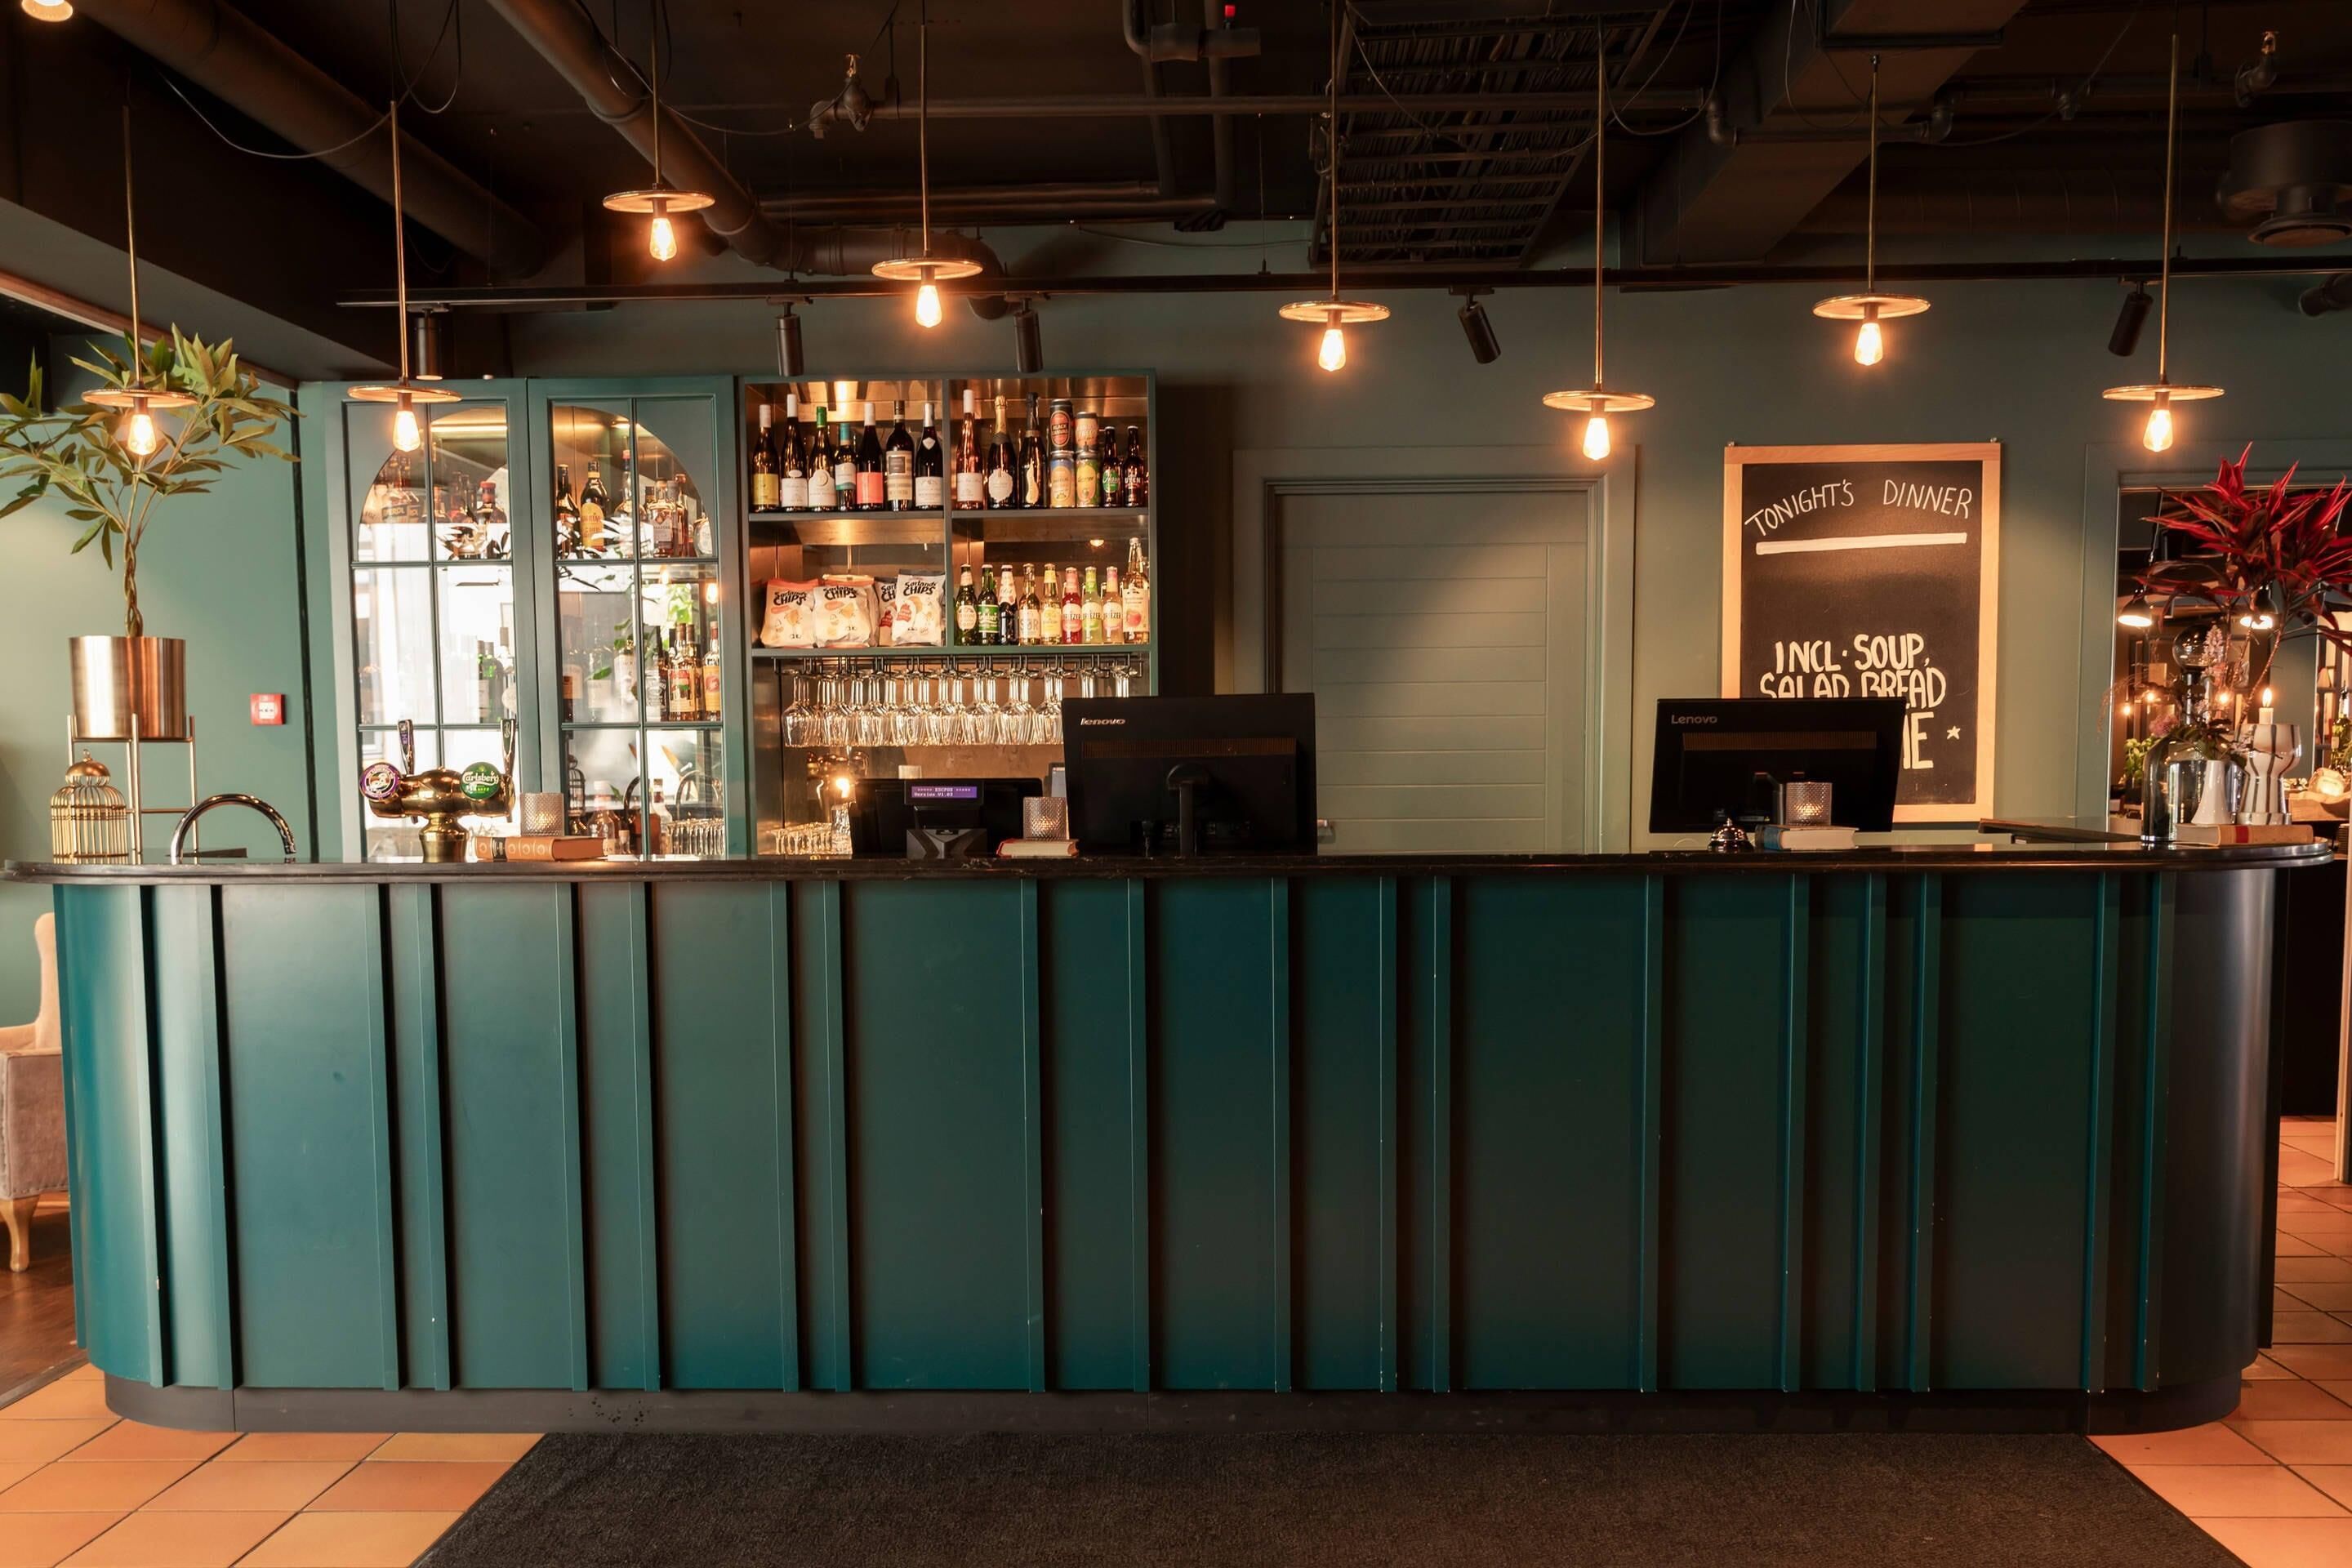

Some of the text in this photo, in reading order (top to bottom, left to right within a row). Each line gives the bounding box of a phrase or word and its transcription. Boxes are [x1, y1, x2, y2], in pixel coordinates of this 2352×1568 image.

[1744, 479, 1972, 536] TONIGHT'S DINNER
[824, 589, 858, 600] CHIPS
[903, 586, 936, 596] CHIPS
[773, 595, 807, 605] CHIPS
[1853, 633, 1930, 670] SOUP,
[1860, 667, 1947, 709] BREAD
[1671, 715, 1717, 724] Lenovo
[462, 770, 499, 785] Carlsberg
